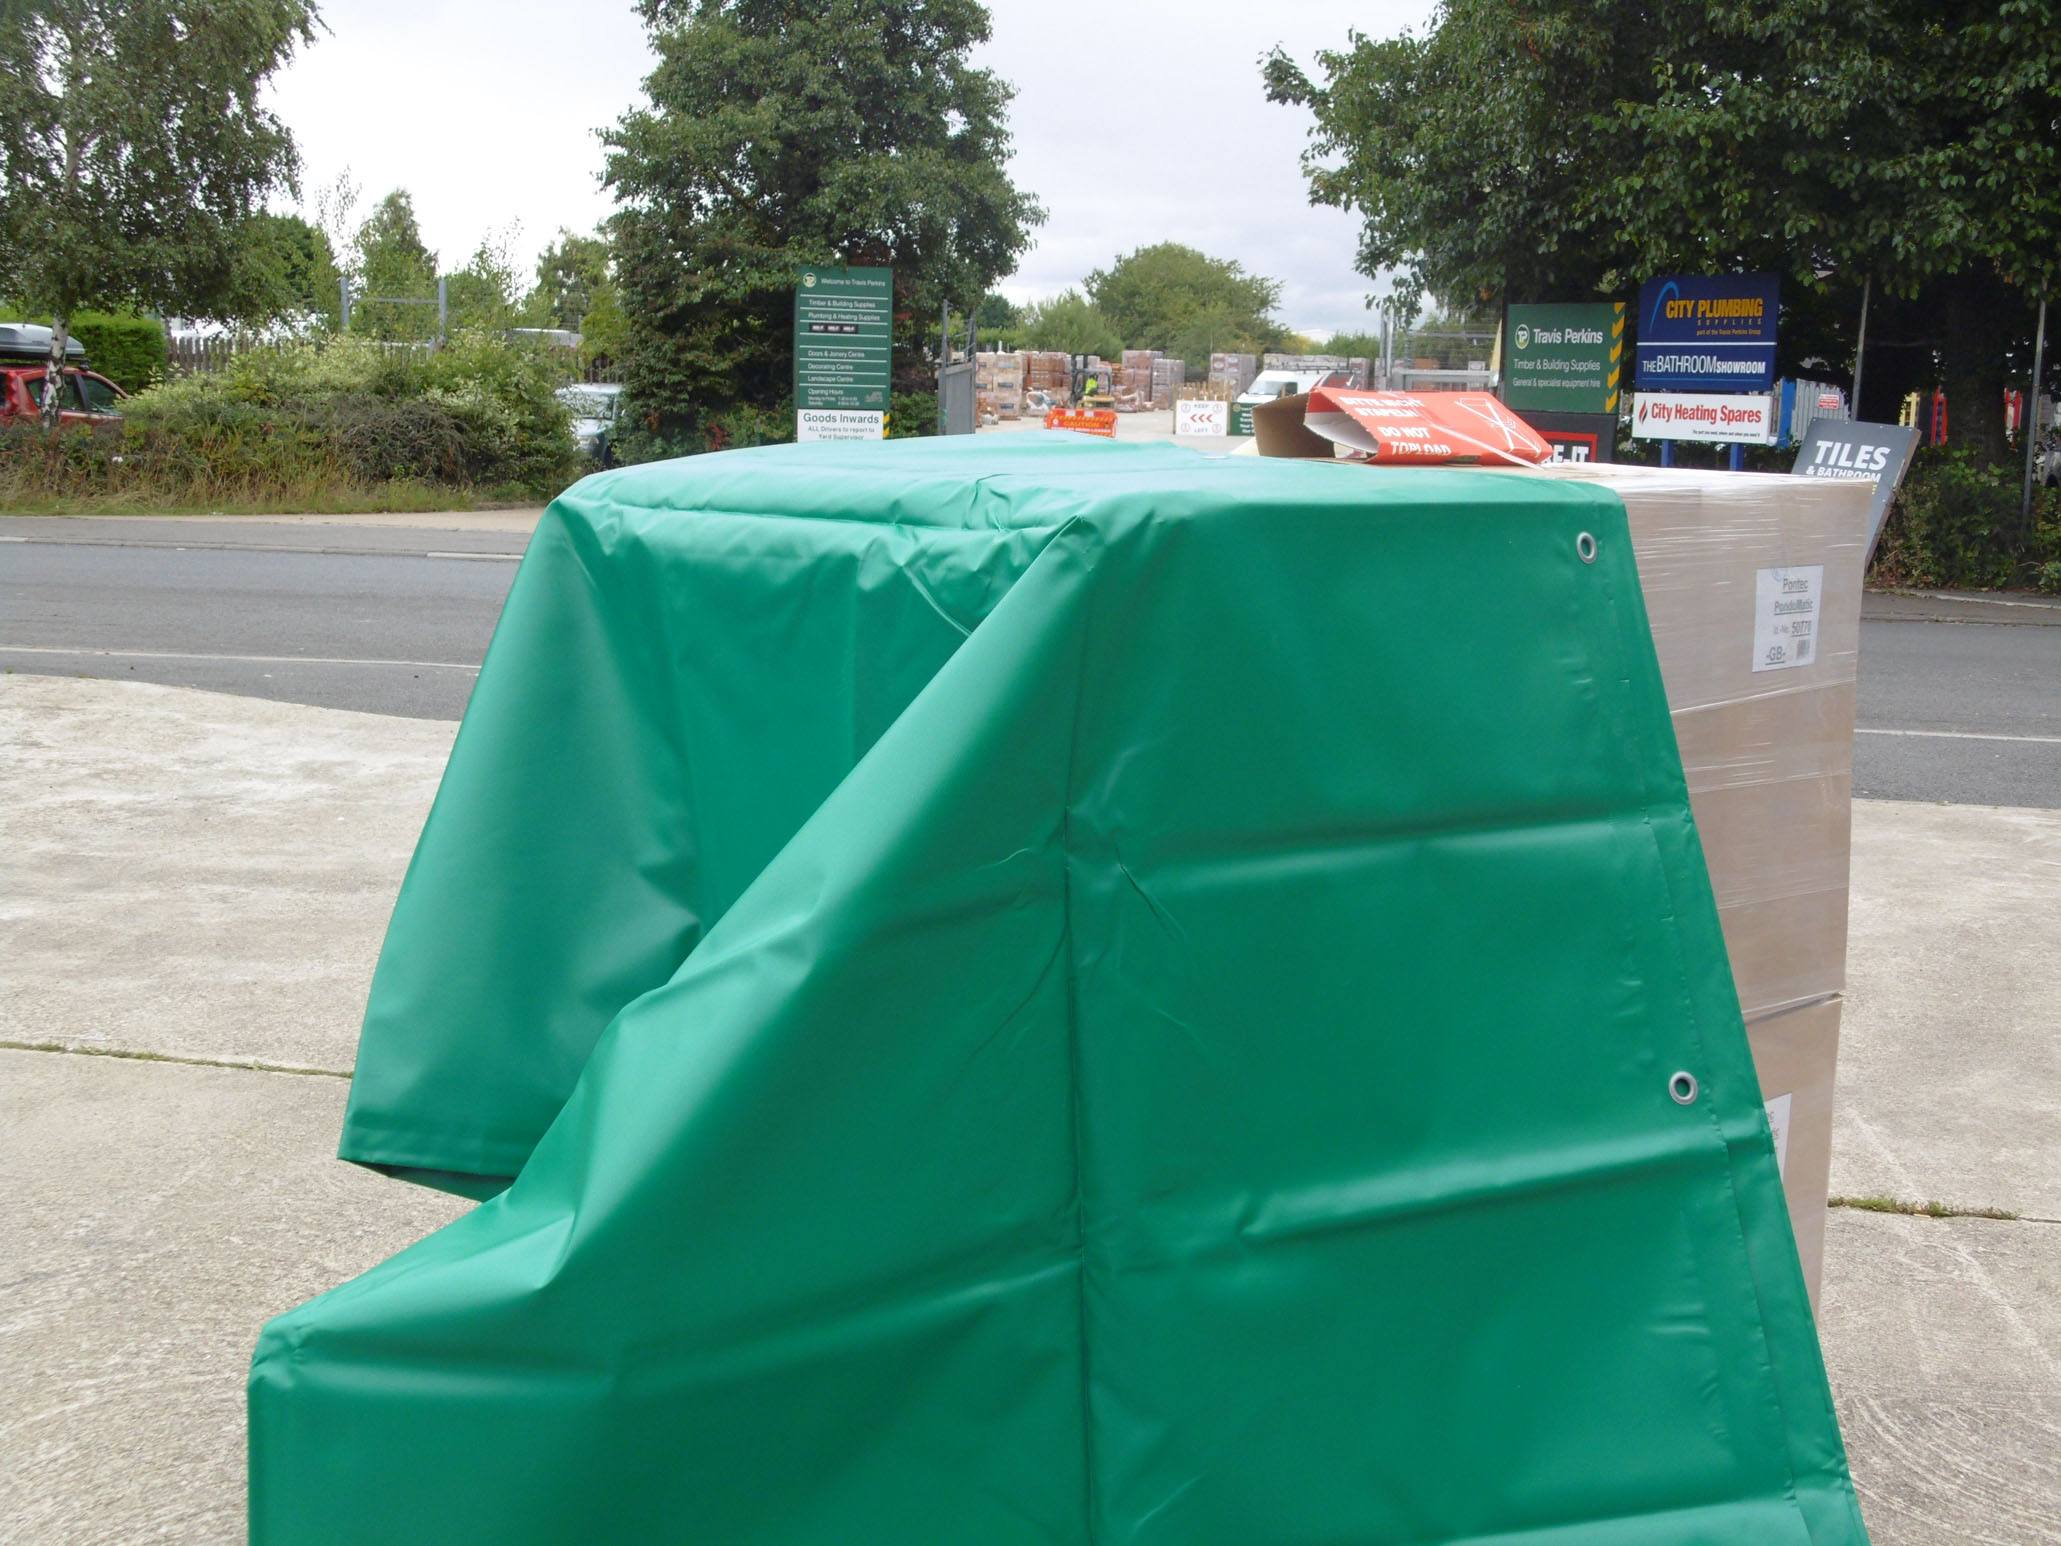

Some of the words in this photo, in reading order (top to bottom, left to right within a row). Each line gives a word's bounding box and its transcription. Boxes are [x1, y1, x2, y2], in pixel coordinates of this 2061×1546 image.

[832, 300, 853, 308] Building
[1666, 300, 1695, 319] CITY
[1697, 298, 1763, 318] PLUMBING
[1533, 328, 1562, 344] Travis
[1564, 328, 1603, 344] Perkins
[1514, 359, 1535, 369] Timber
[1536, 359, 1541, 370] &
[1543, 359, 1570, 373] Building
[1571, 360, 1600, 372] Supplies
[1643, 361, 1656, 373] THE
[1656, 355, 1717, 374] BATHROOM
[1717, 361, 1766, 374] SHOWROOM
[1512, 377, 1533, 386] General
[803, 413, 837, 423] Goods
[840, 413, 880, 424] Inwards
[1651, 403, 1672, 423] City
[1675, 403, 1718, 425] Heating
[1720, 405, 1761, 426] Spares
[1378, 426, 1401, 437] DO
[1401, 427, 1430, 438] NOT
[1390, 441, 1452, 456] TOPLOAD
[1541, 445, 1589, 463] E-IT
[1815, 440, 1891, 471] TILES
[1806, 465, 1816, 475] &
[1817, 466, 1882, 483] BATHROOM
[1783, 578, 1808, 590] Pontec
